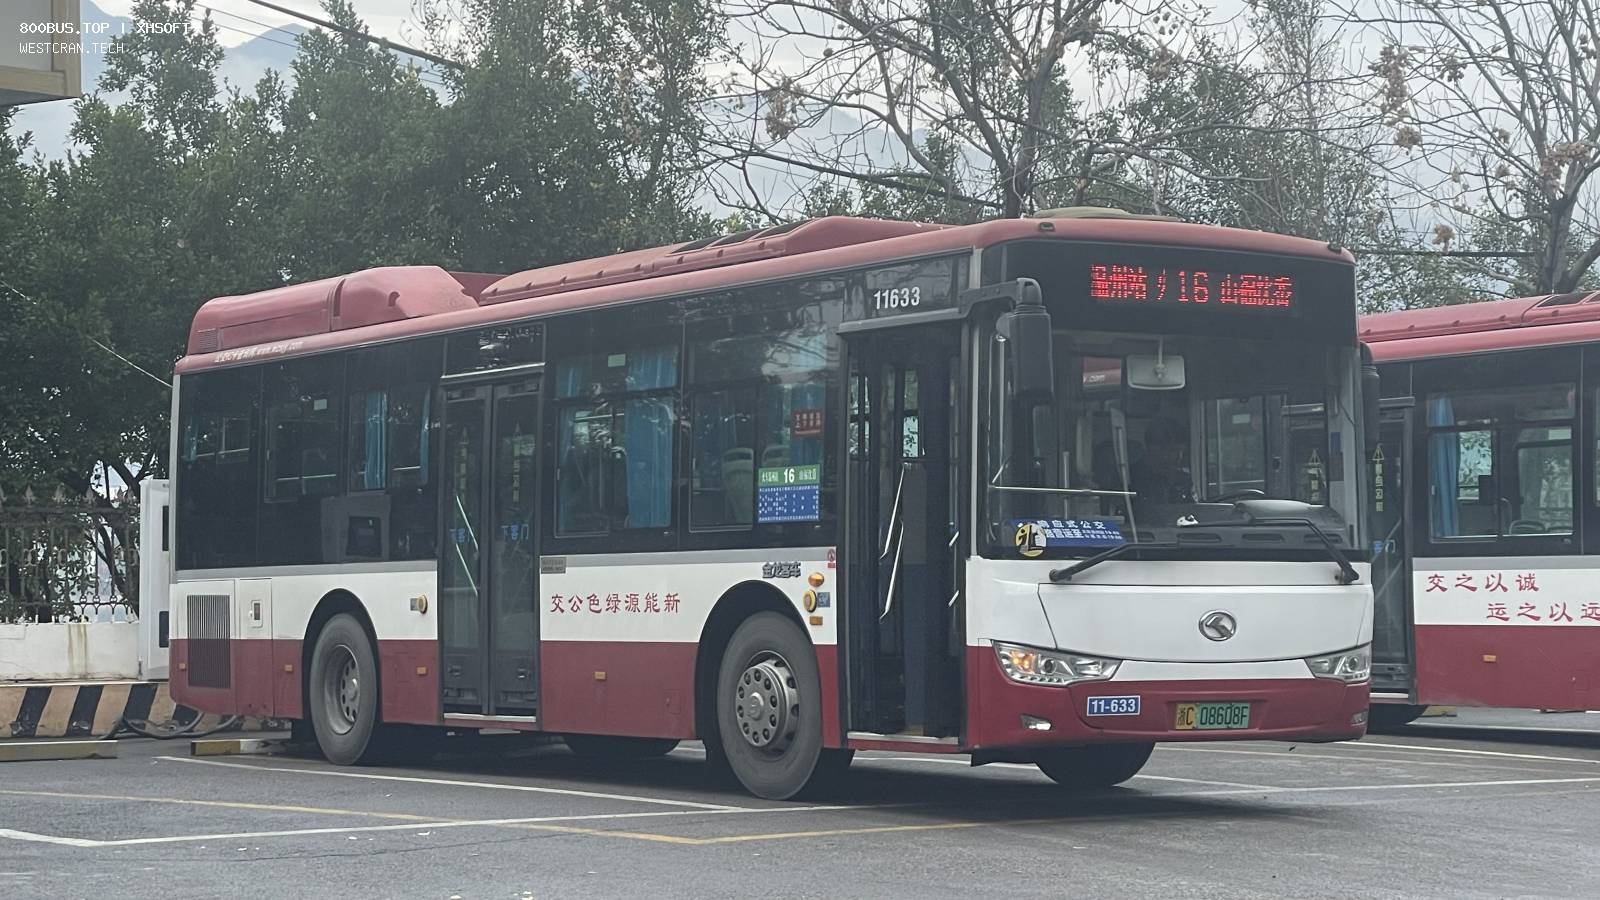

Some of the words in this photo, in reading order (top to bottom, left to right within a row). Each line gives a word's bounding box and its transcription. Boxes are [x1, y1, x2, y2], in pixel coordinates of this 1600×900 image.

[1178, 271, 1210, 303] 16
[873, 286, 921, 310] 11633
[783, 468, 796, 484] 16
[1425, 573, 1540, 592] 交之以诚
[1486, 602, 1600, 622] 运之以远
[1091, 698, 1136, 713] 11-633
[1199, 705, 1249, 727] 08608F
